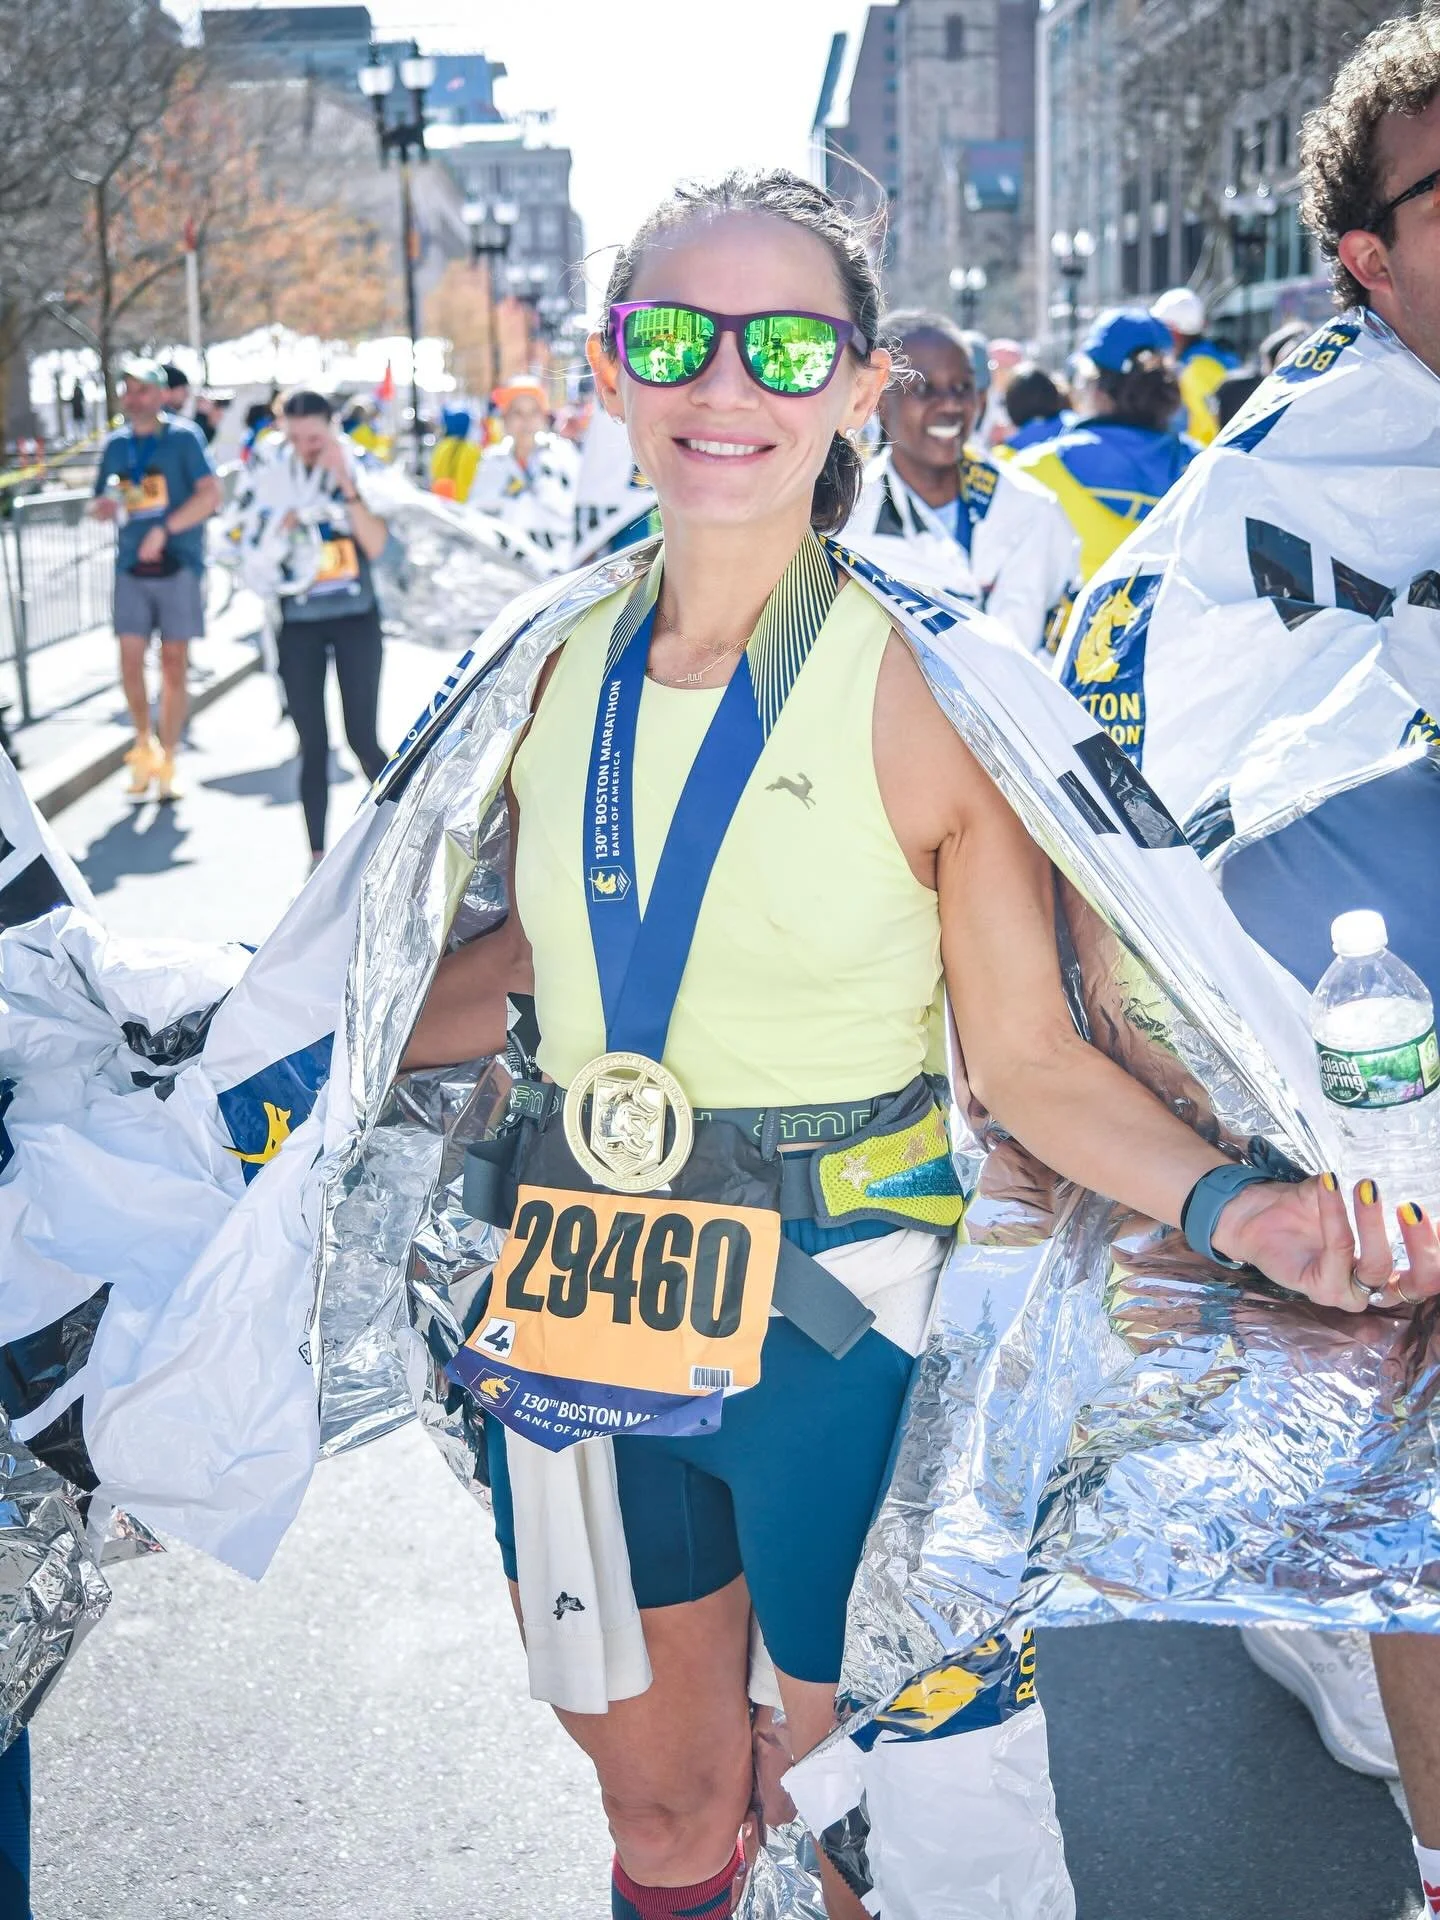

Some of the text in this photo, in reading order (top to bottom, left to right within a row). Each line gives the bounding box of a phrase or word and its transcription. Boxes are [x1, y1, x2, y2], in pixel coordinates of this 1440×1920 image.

[600, 680, 622, 762] MARATHON
[595, 764, 610, 826] BOSTON
[611, 750, 621, 857] BANK OF AMERICA
[505, 1199, 752, 1338] 29460
[485, 1325, 510, 1351] 4
[513, 1409, 551, 1430] BANK
[553, 1424, 572, 1434] OF
[520, 1392, 559, 1413] 130TH
[557, 1401, 621, 1427] BOSTON
